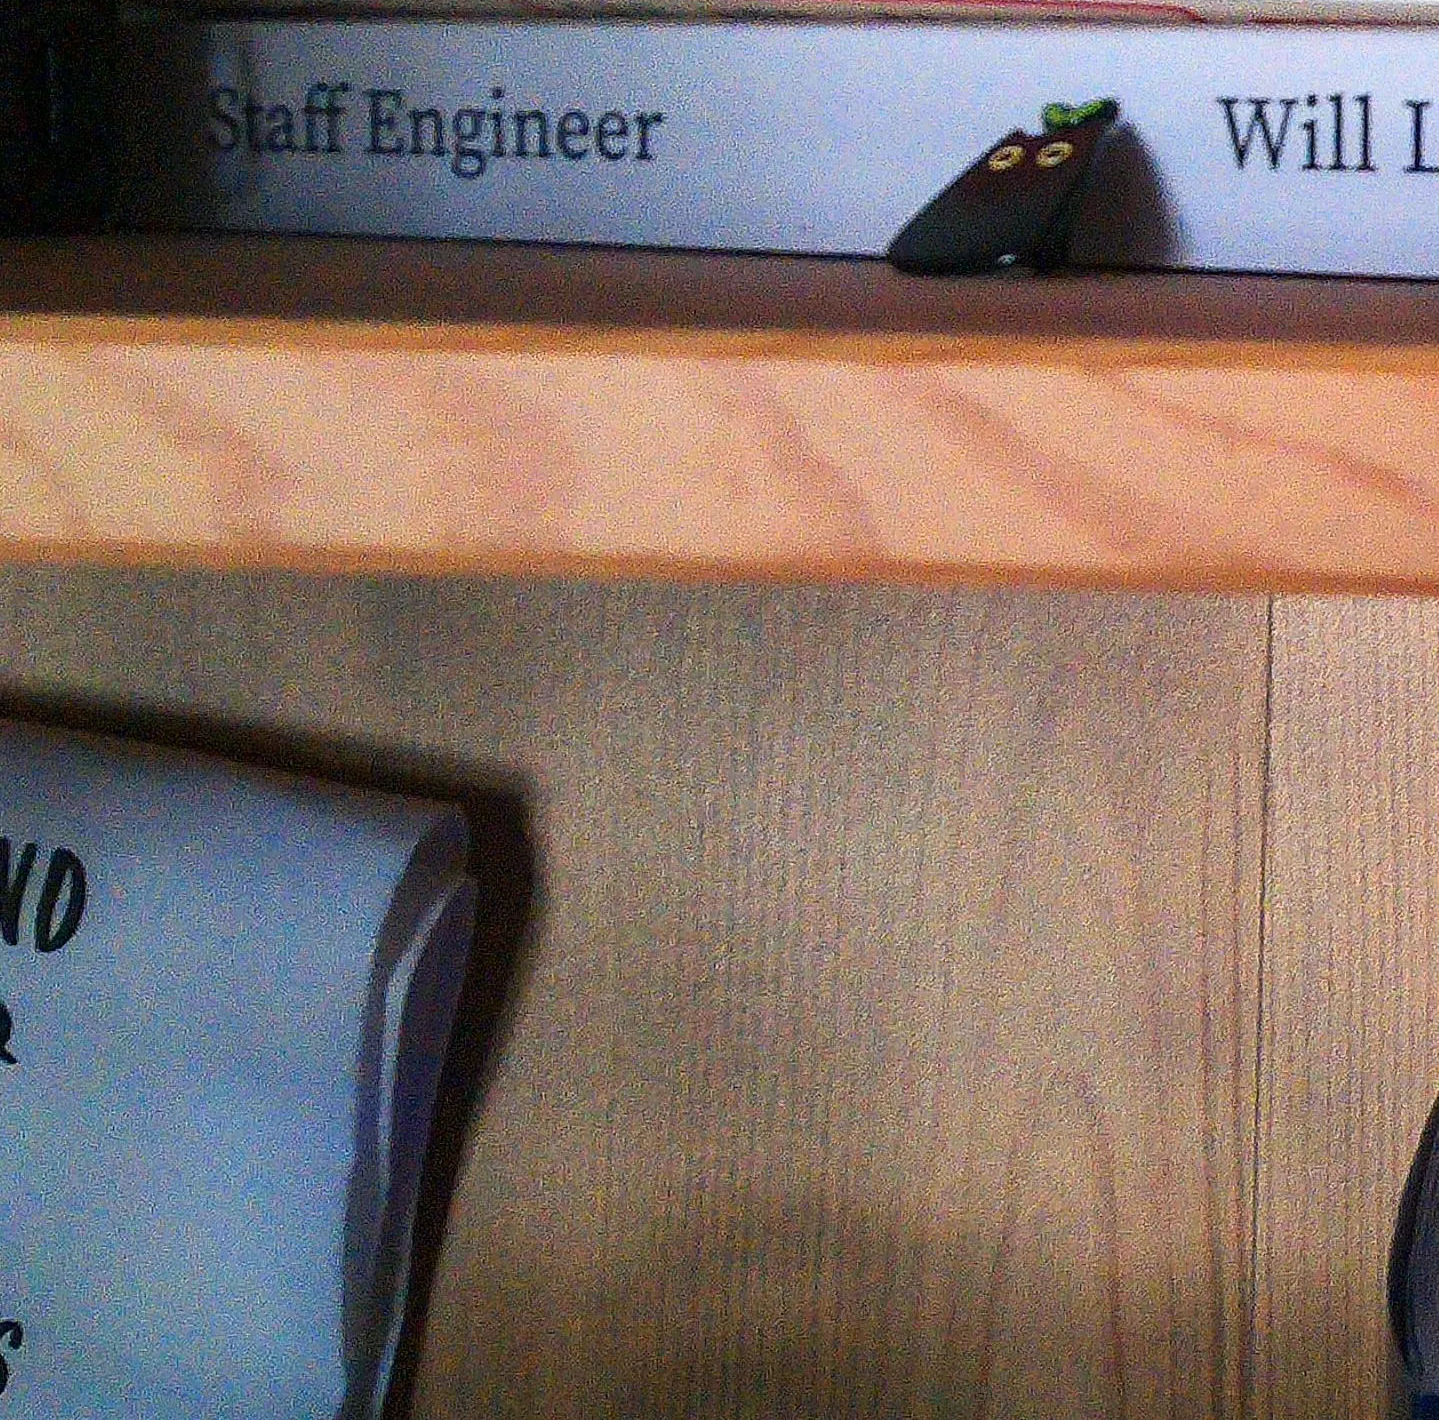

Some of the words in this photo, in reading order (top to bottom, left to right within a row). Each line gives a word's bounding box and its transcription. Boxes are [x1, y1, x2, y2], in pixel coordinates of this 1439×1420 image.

[207, 81, 350, 158] Staff
[367, 87, 664, 178] Engineer
[1217, 94, 1376, 172] Will
